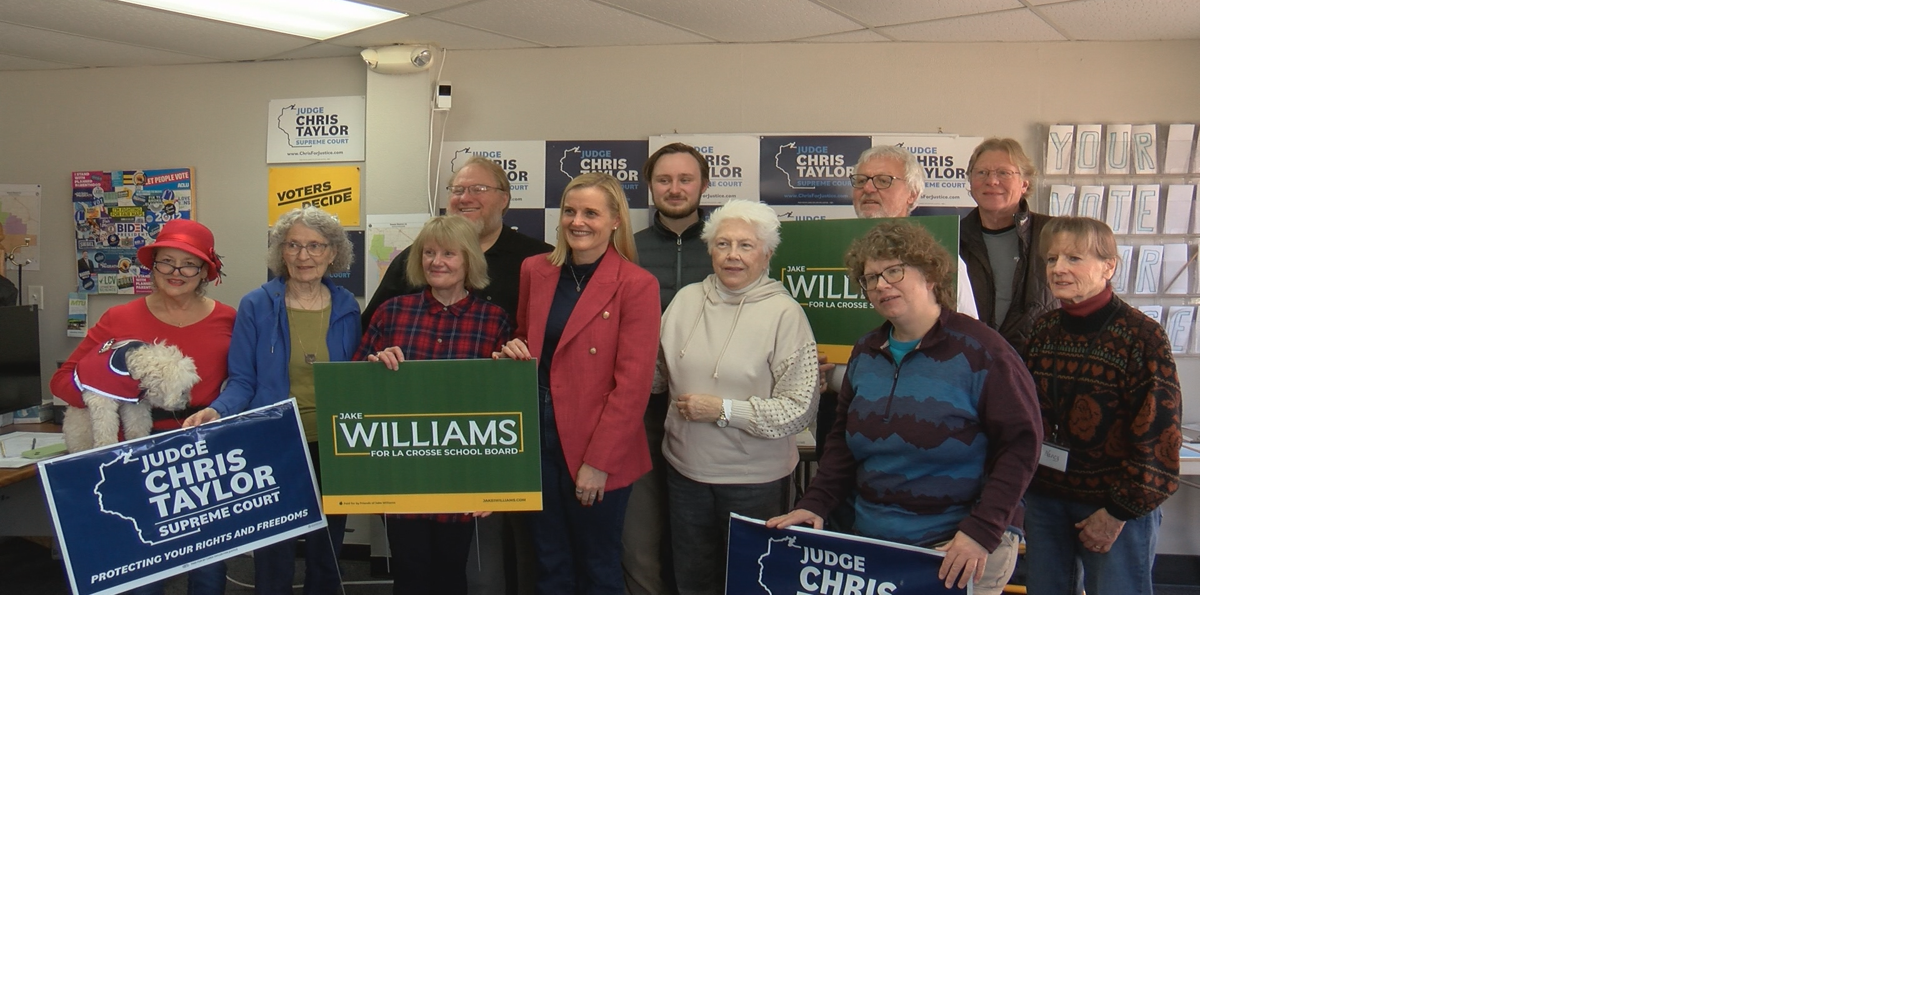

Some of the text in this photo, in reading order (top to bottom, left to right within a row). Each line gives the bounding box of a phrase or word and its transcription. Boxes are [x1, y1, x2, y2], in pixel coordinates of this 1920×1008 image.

[296, 106, 324, 116] JUDGE
[296, 114, 338, 126] CHRIS
[296, 125, 348, 136] TAYLOR
[581, 150, 611, 158] JUDGE
[797, 146, 828, 154] JUDGE
[1050, 131, 1155, 170] YOUR
[493, 160, 517, 170] RIS
[580, 158, 628, 170] CHRIS
[705, 155, 730, 166] RIS
[796, 154, 844, 166] CHRIS
[917, 156, 954, 166] HRIS
[154, 172, 174, 183] PEOPLE
[174, 171, 189, 180] VOTE
[709, 167, 742, 178] LOR
[796, 166, 854, 178] TAYLOR
[924, 168, 966, 178] YLOR
[276, 182, 332, 201] VOTERS
[302, 192, 352, 209] DECIDE
[117, 224, 148, 232] BIDEN
[786, 274, 866, 299] WILL
[340, 419, 518, 448] WILLIAMS
[142, 440, 209, 473] JUDGE
[145, 449, 246, 494] CHRIS
[149, 465, 276, 518] TAYLOR
[159, 491, 280, 537] SUPREME COURT
[90, 555, 162, 584] PROTECTING
[164, 545, 194, 561] YOUR
[196, 532, 232, 551] RIGHTS
[234, 525, 255, 539] AND
[257, 509, 308, 532] FREEDOMS
[800, 546, 866, 572] JUDGE
